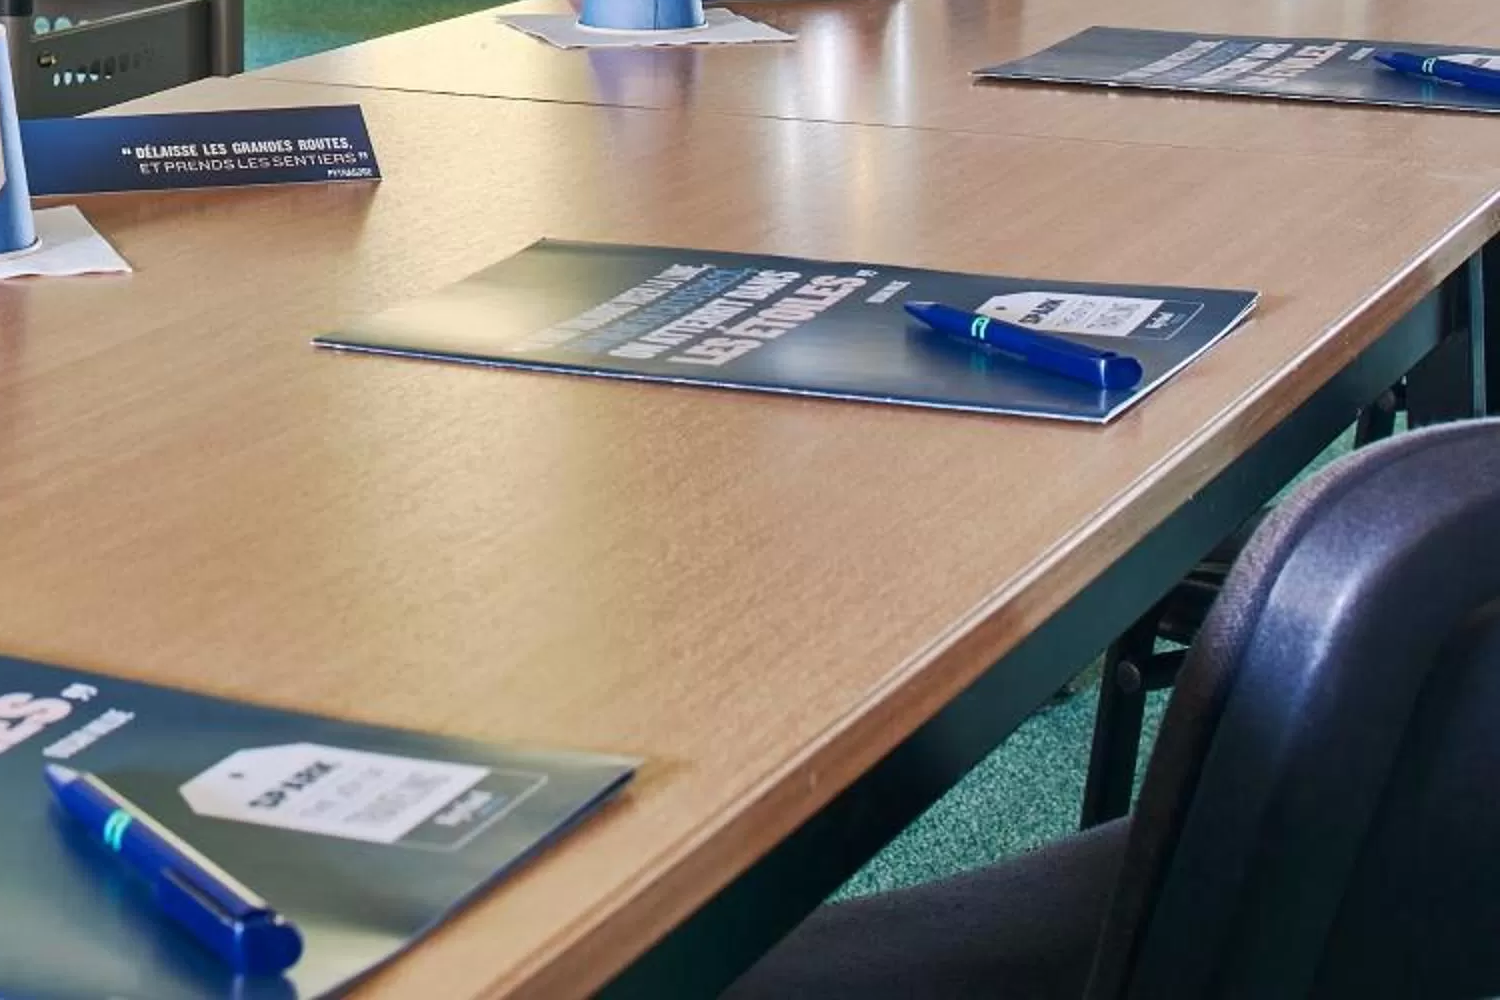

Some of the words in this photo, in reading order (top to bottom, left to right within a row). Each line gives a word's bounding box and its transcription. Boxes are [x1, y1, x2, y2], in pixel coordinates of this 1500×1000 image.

[202, 143, 227, 156] LES
[231, 139, 293, 155] GRANDES
[140, 162, 161, 174] ET
[163, 159, 235, 172] PRENDS
[237, 157, 270, 169] LES
